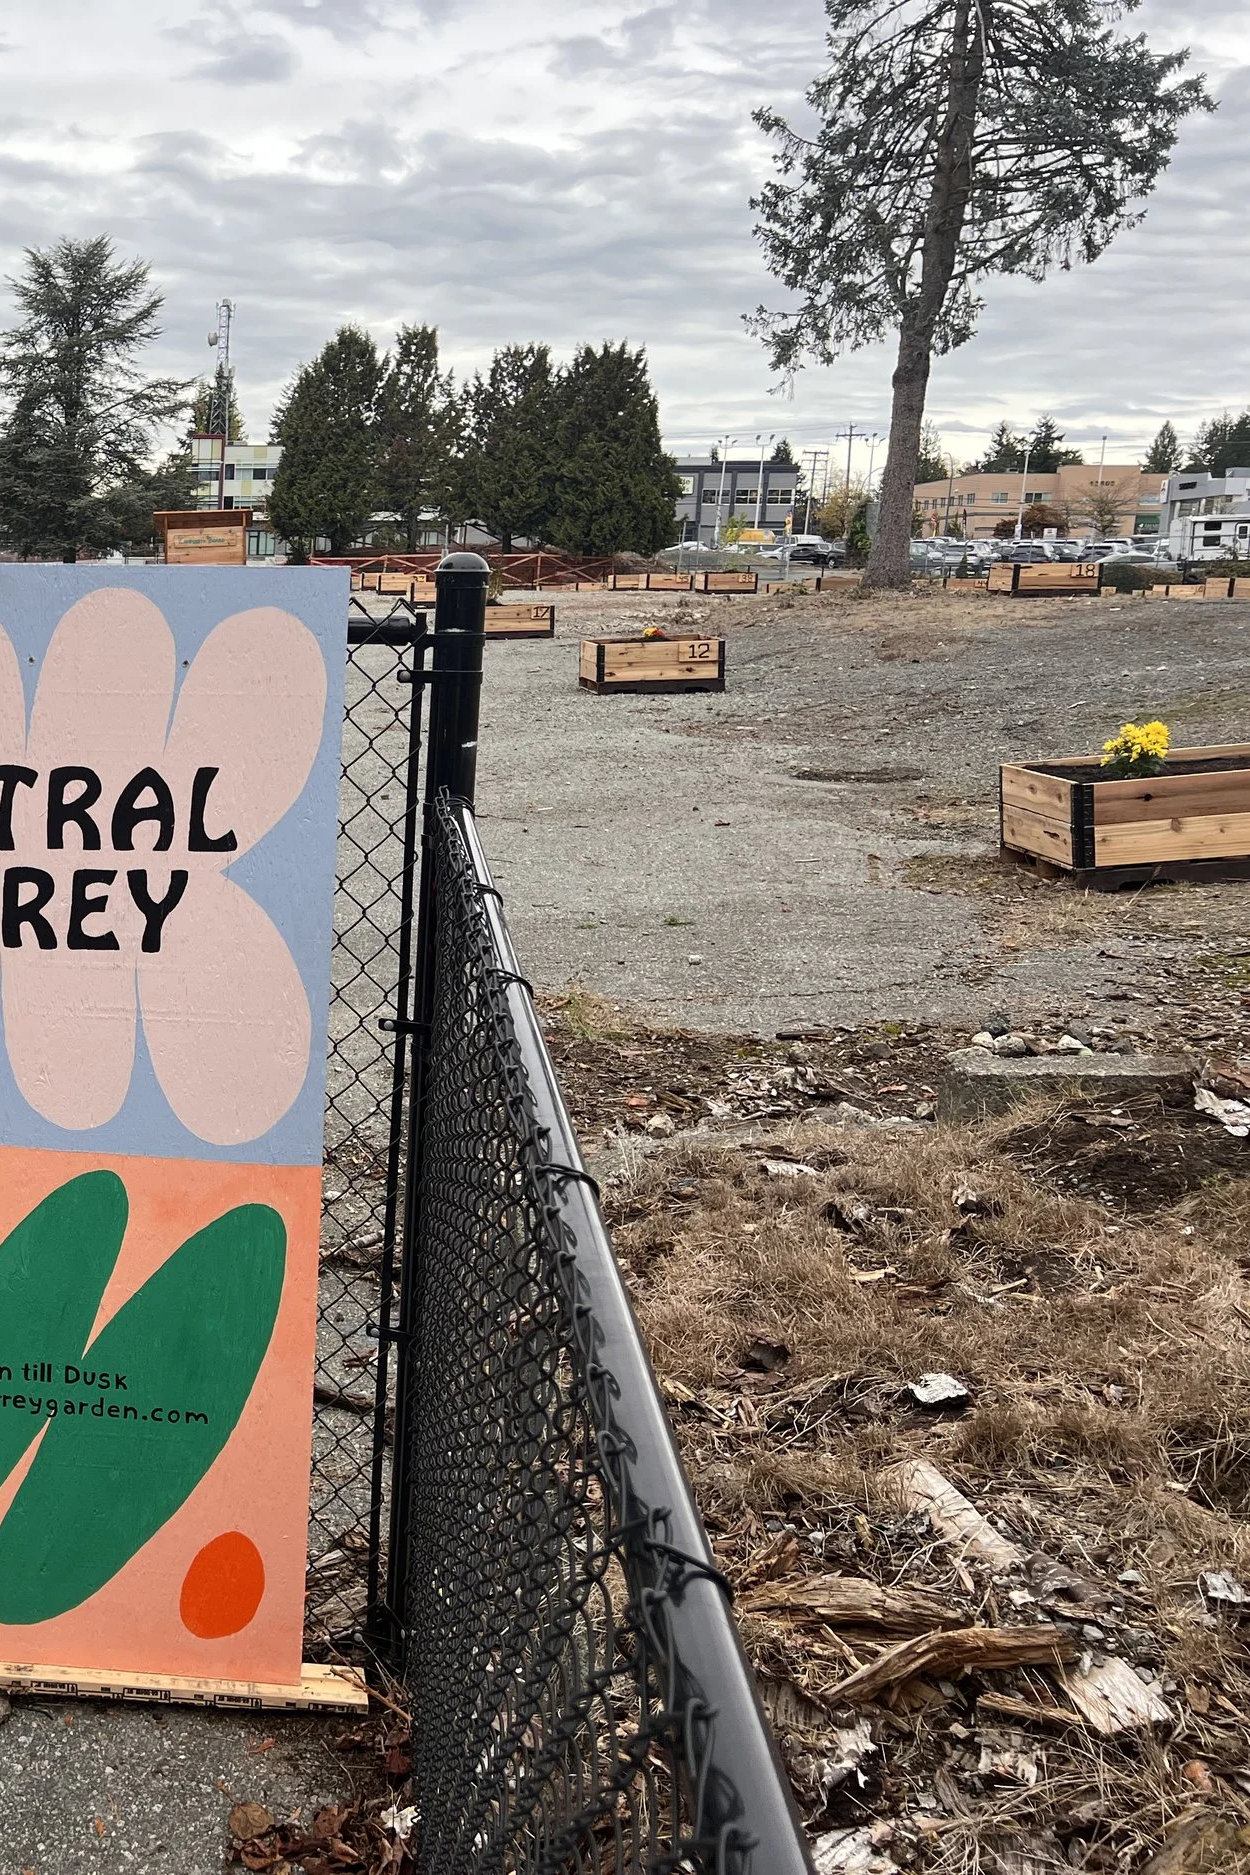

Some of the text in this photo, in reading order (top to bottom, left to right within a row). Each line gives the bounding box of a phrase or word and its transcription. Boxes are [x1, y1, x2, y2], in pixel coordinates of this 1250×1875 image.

[1076, 564, 1096, 577] 18
[533, 606, 550, 618] 17
[687, 642, 711, 660] 12
[22, 1363, 54, 1384] till
[65, 1365, 129, 1391] Dusk
